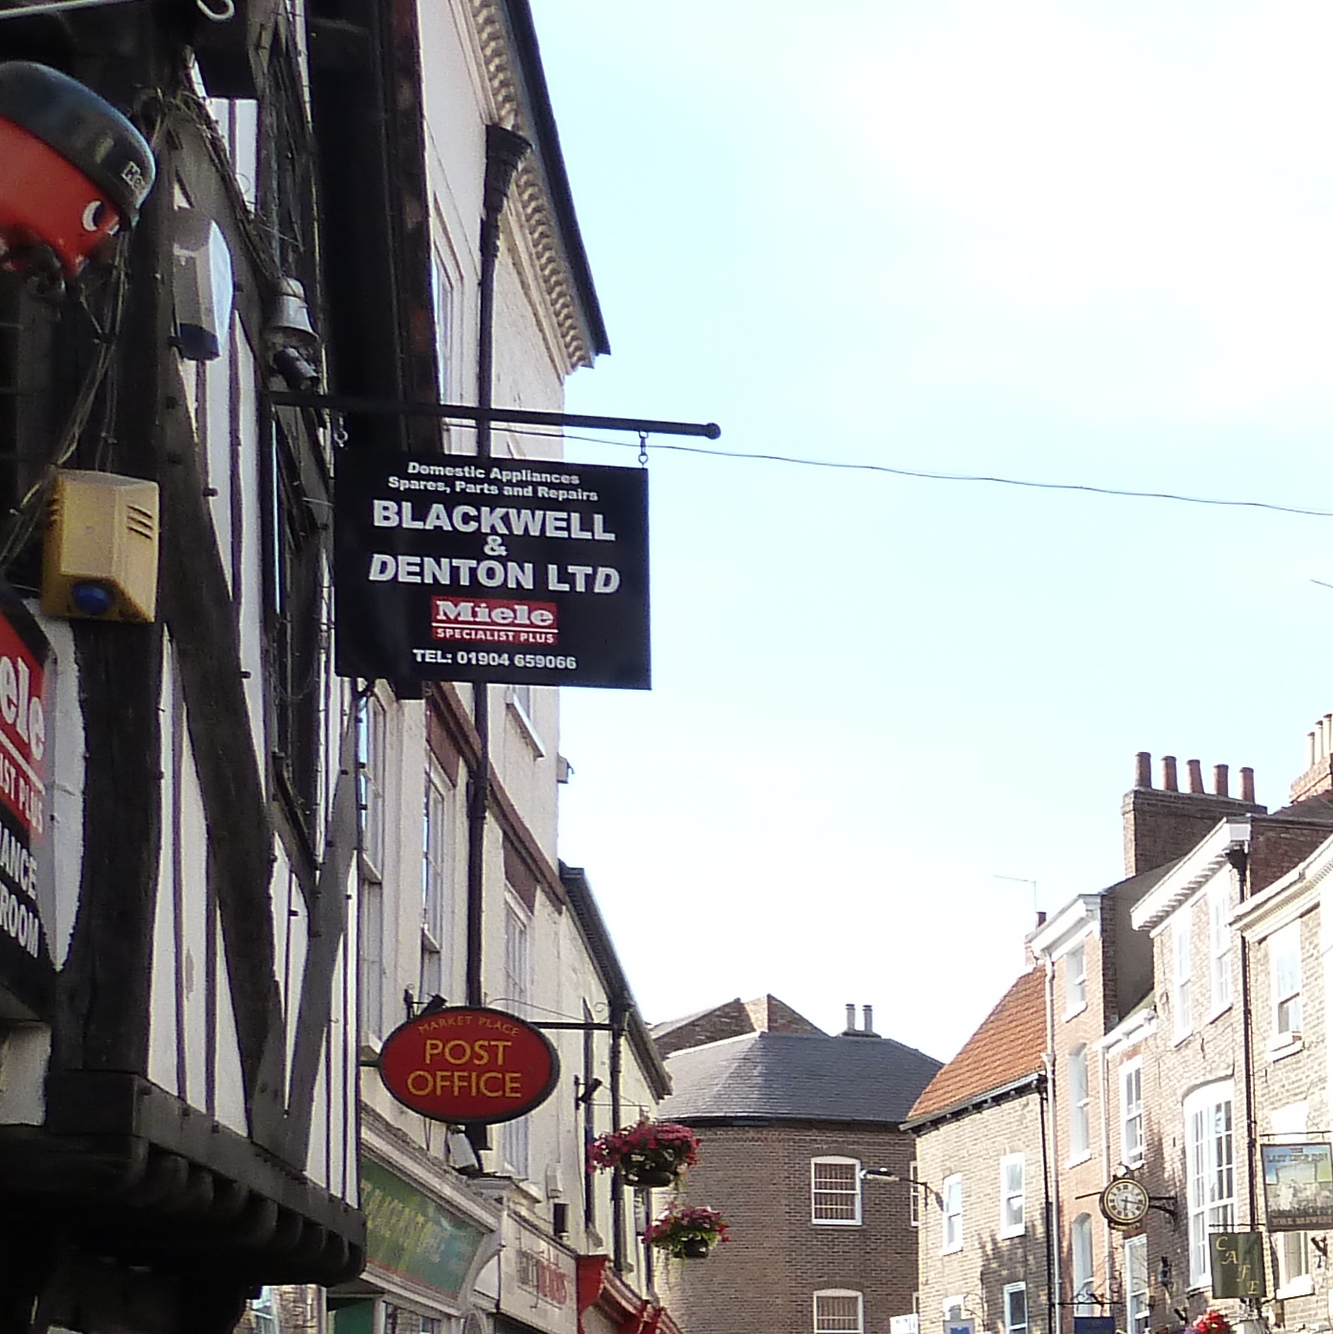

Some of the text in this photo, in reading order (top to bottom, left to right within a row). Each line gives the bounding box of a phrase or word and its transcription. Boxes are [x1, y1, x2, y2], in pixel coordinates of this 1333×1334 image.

[407, 461, 580, 485] Domestic Appliances
[388, 476, 598, 502] Spares, Parts and Repairs
[372, 499, 616, 542] BLACKWELL
[483, 535, 508, 557] &
[368, 553, 621, 594] DENTON LTD
[435, 600, 554, 627] Miele
[436, 627, 554, 644] SPECIALIST PLUS
[412, 648, 577, 669] TEL: 01904 659066
[19, 777, 43, 834] PLUS
[418, 1016, 519, 1037] MARKET PLACE
[425, 1040, 512, 1065] POST
[406, 1070, 521, 1097] OFFICE
